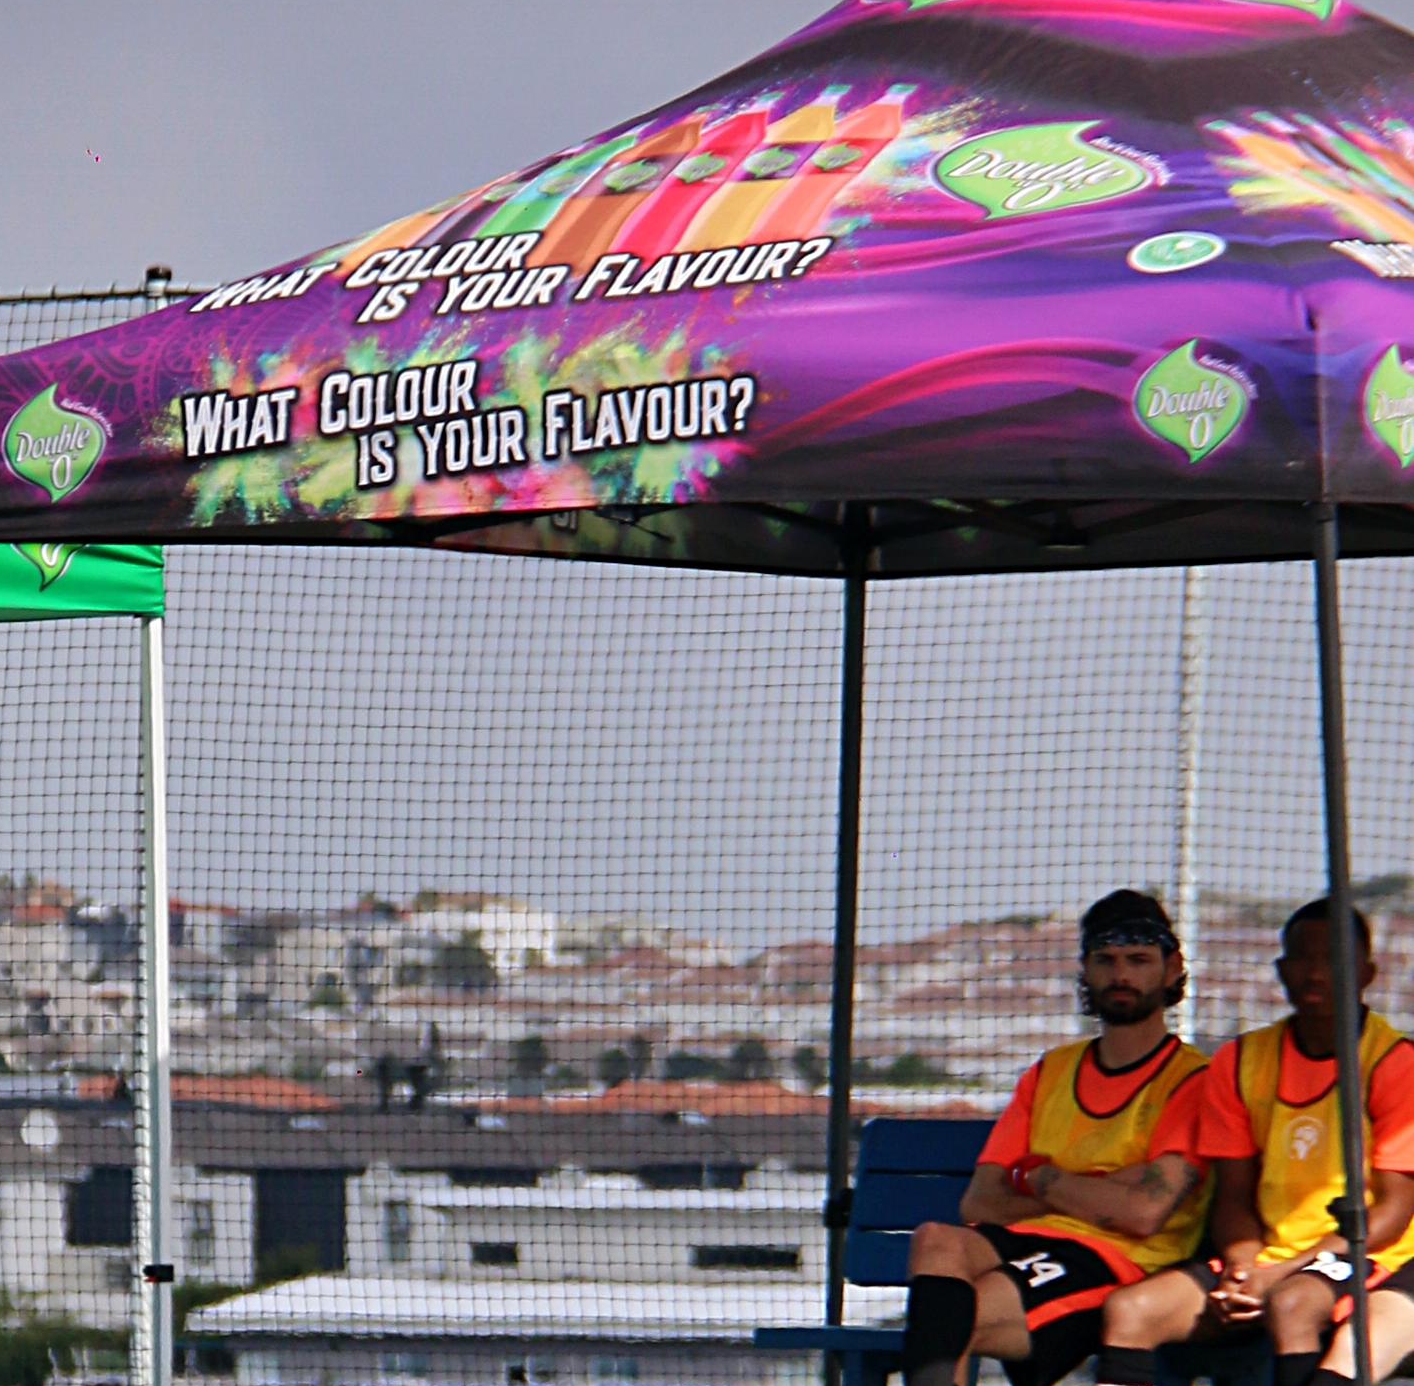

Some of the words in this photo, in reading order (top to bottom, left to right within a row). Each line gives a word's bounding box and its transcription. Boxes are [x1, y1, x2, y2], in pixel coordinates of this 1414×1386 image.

[947, 149, 1127, 187] Double
[188, 262, 338, 314] WHAT
[344, 231, 542, 289] COLOUR
[355, 281, 420, 325] IS
[436, 265, 569, 316] YOUR
[573, 237, 834, 301] FLAVOUR?
[182, 388, 297, 458] WHAT
[319, 359, 477, 435] COLOUR
[1147, 378, 1232, 418] Double
[16, 421, 91, 463] Double
[356, 430, 397, 487] IS
[417, 408, 527, 477] YOUR
[543, 376, 755, 457] FLAVOUR?
[1010, 1251, 1067, 1289] 14
